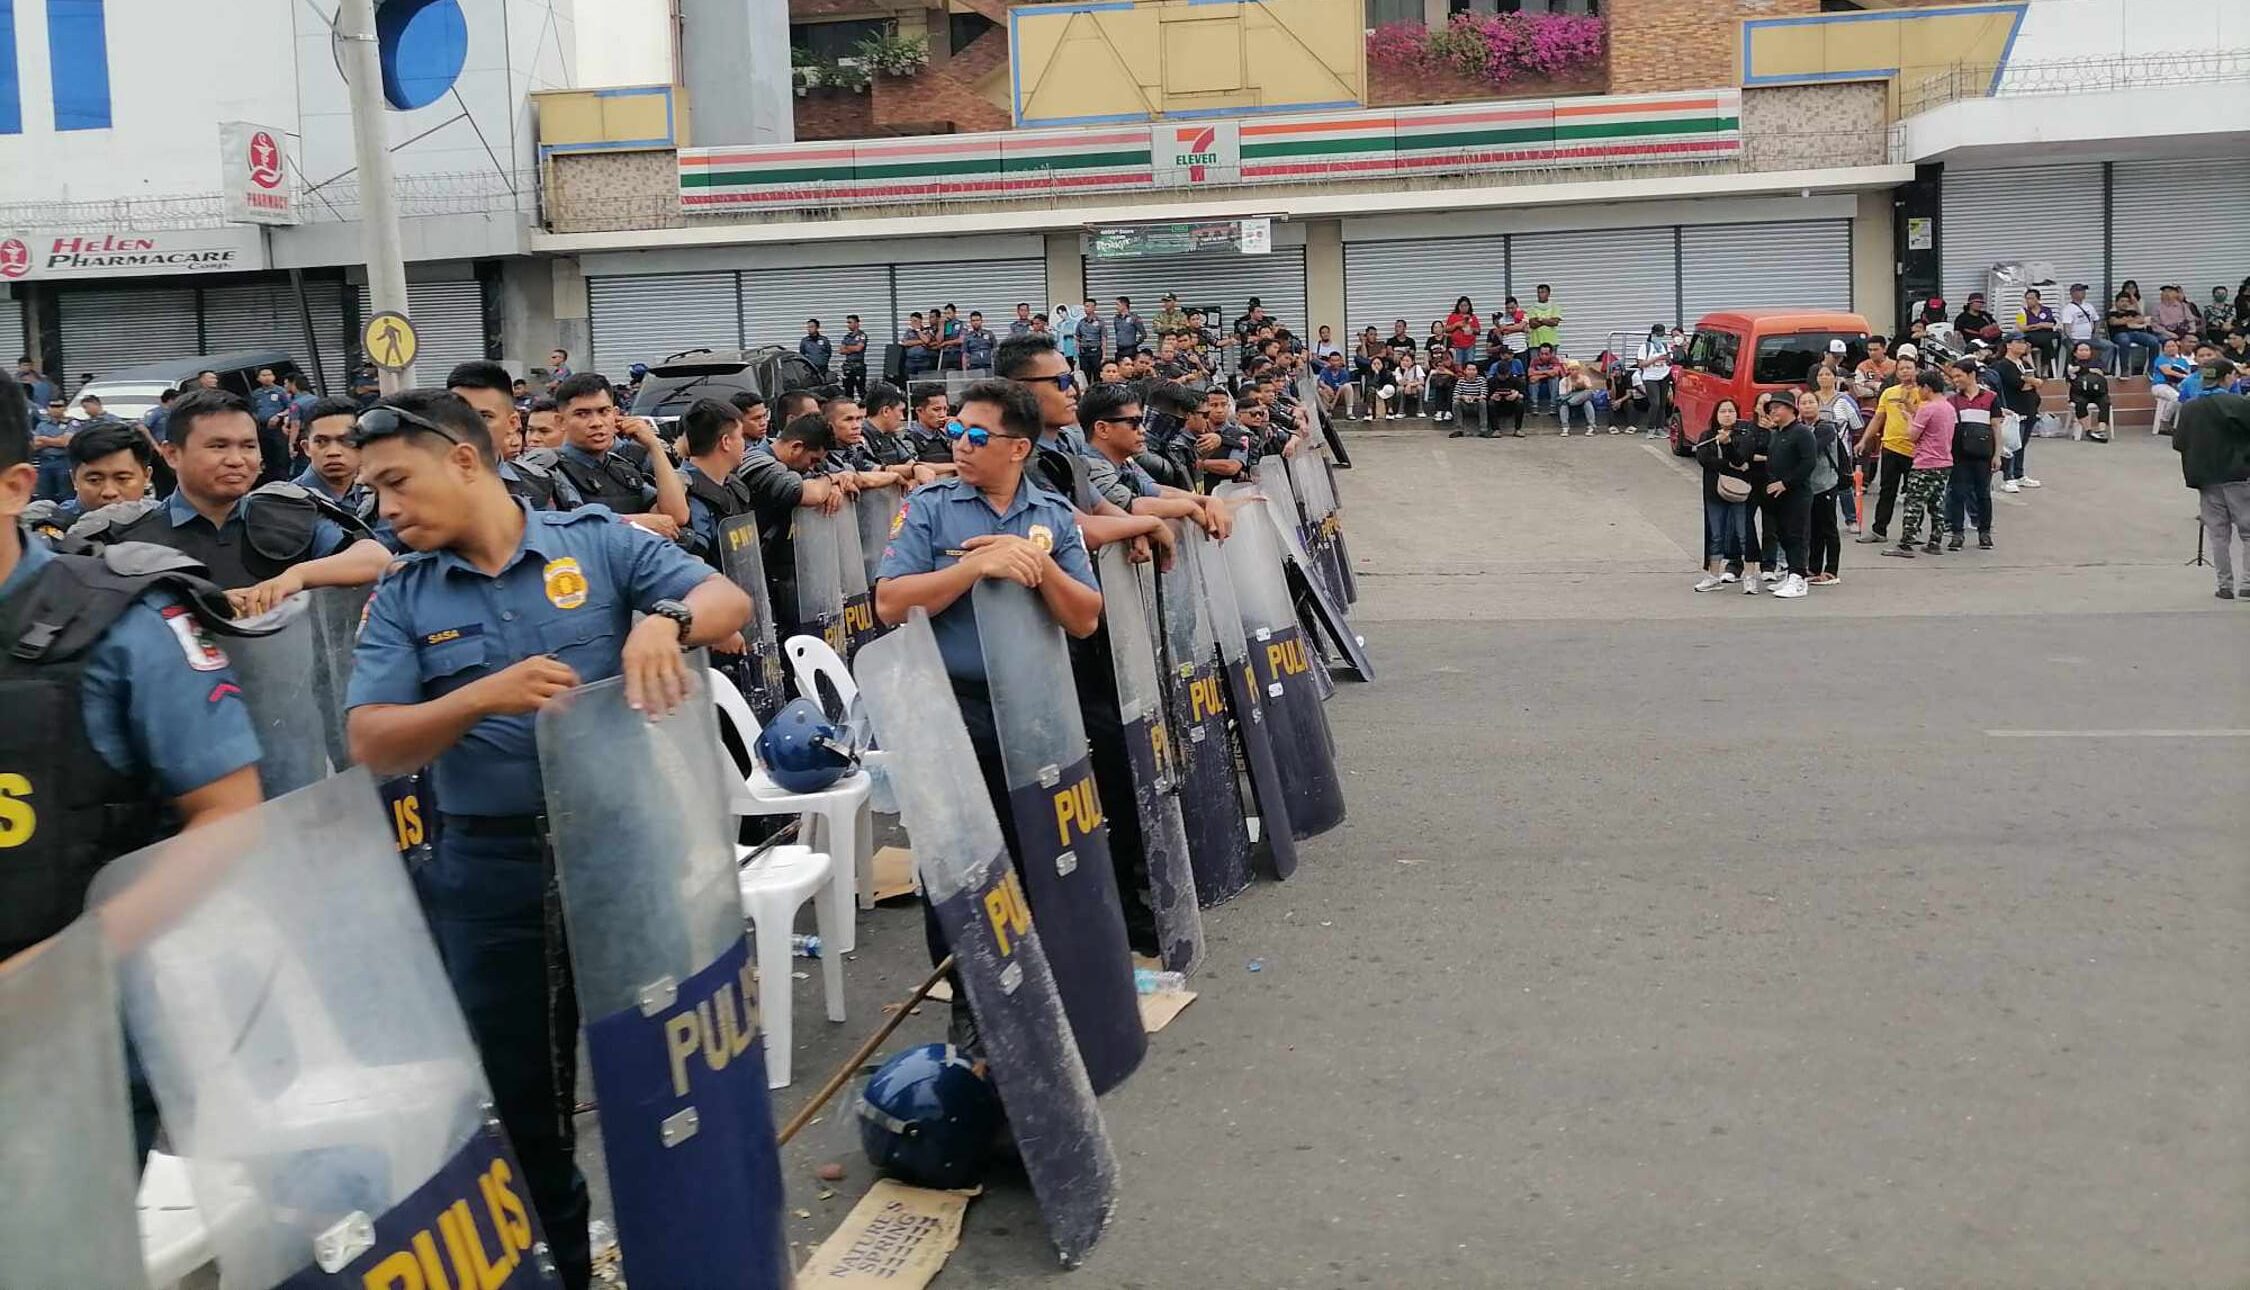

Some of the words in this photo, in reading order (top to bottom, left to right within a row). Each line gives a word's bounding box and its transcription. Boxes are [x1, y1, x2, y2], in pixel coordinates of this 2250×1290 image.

[1176, 127, 1215, 182] 7
[247, 192, 288, 210] PHARMACY
[428, 630, 460, 644] SASA
[858, 1215, 916, 1273] SPRING
